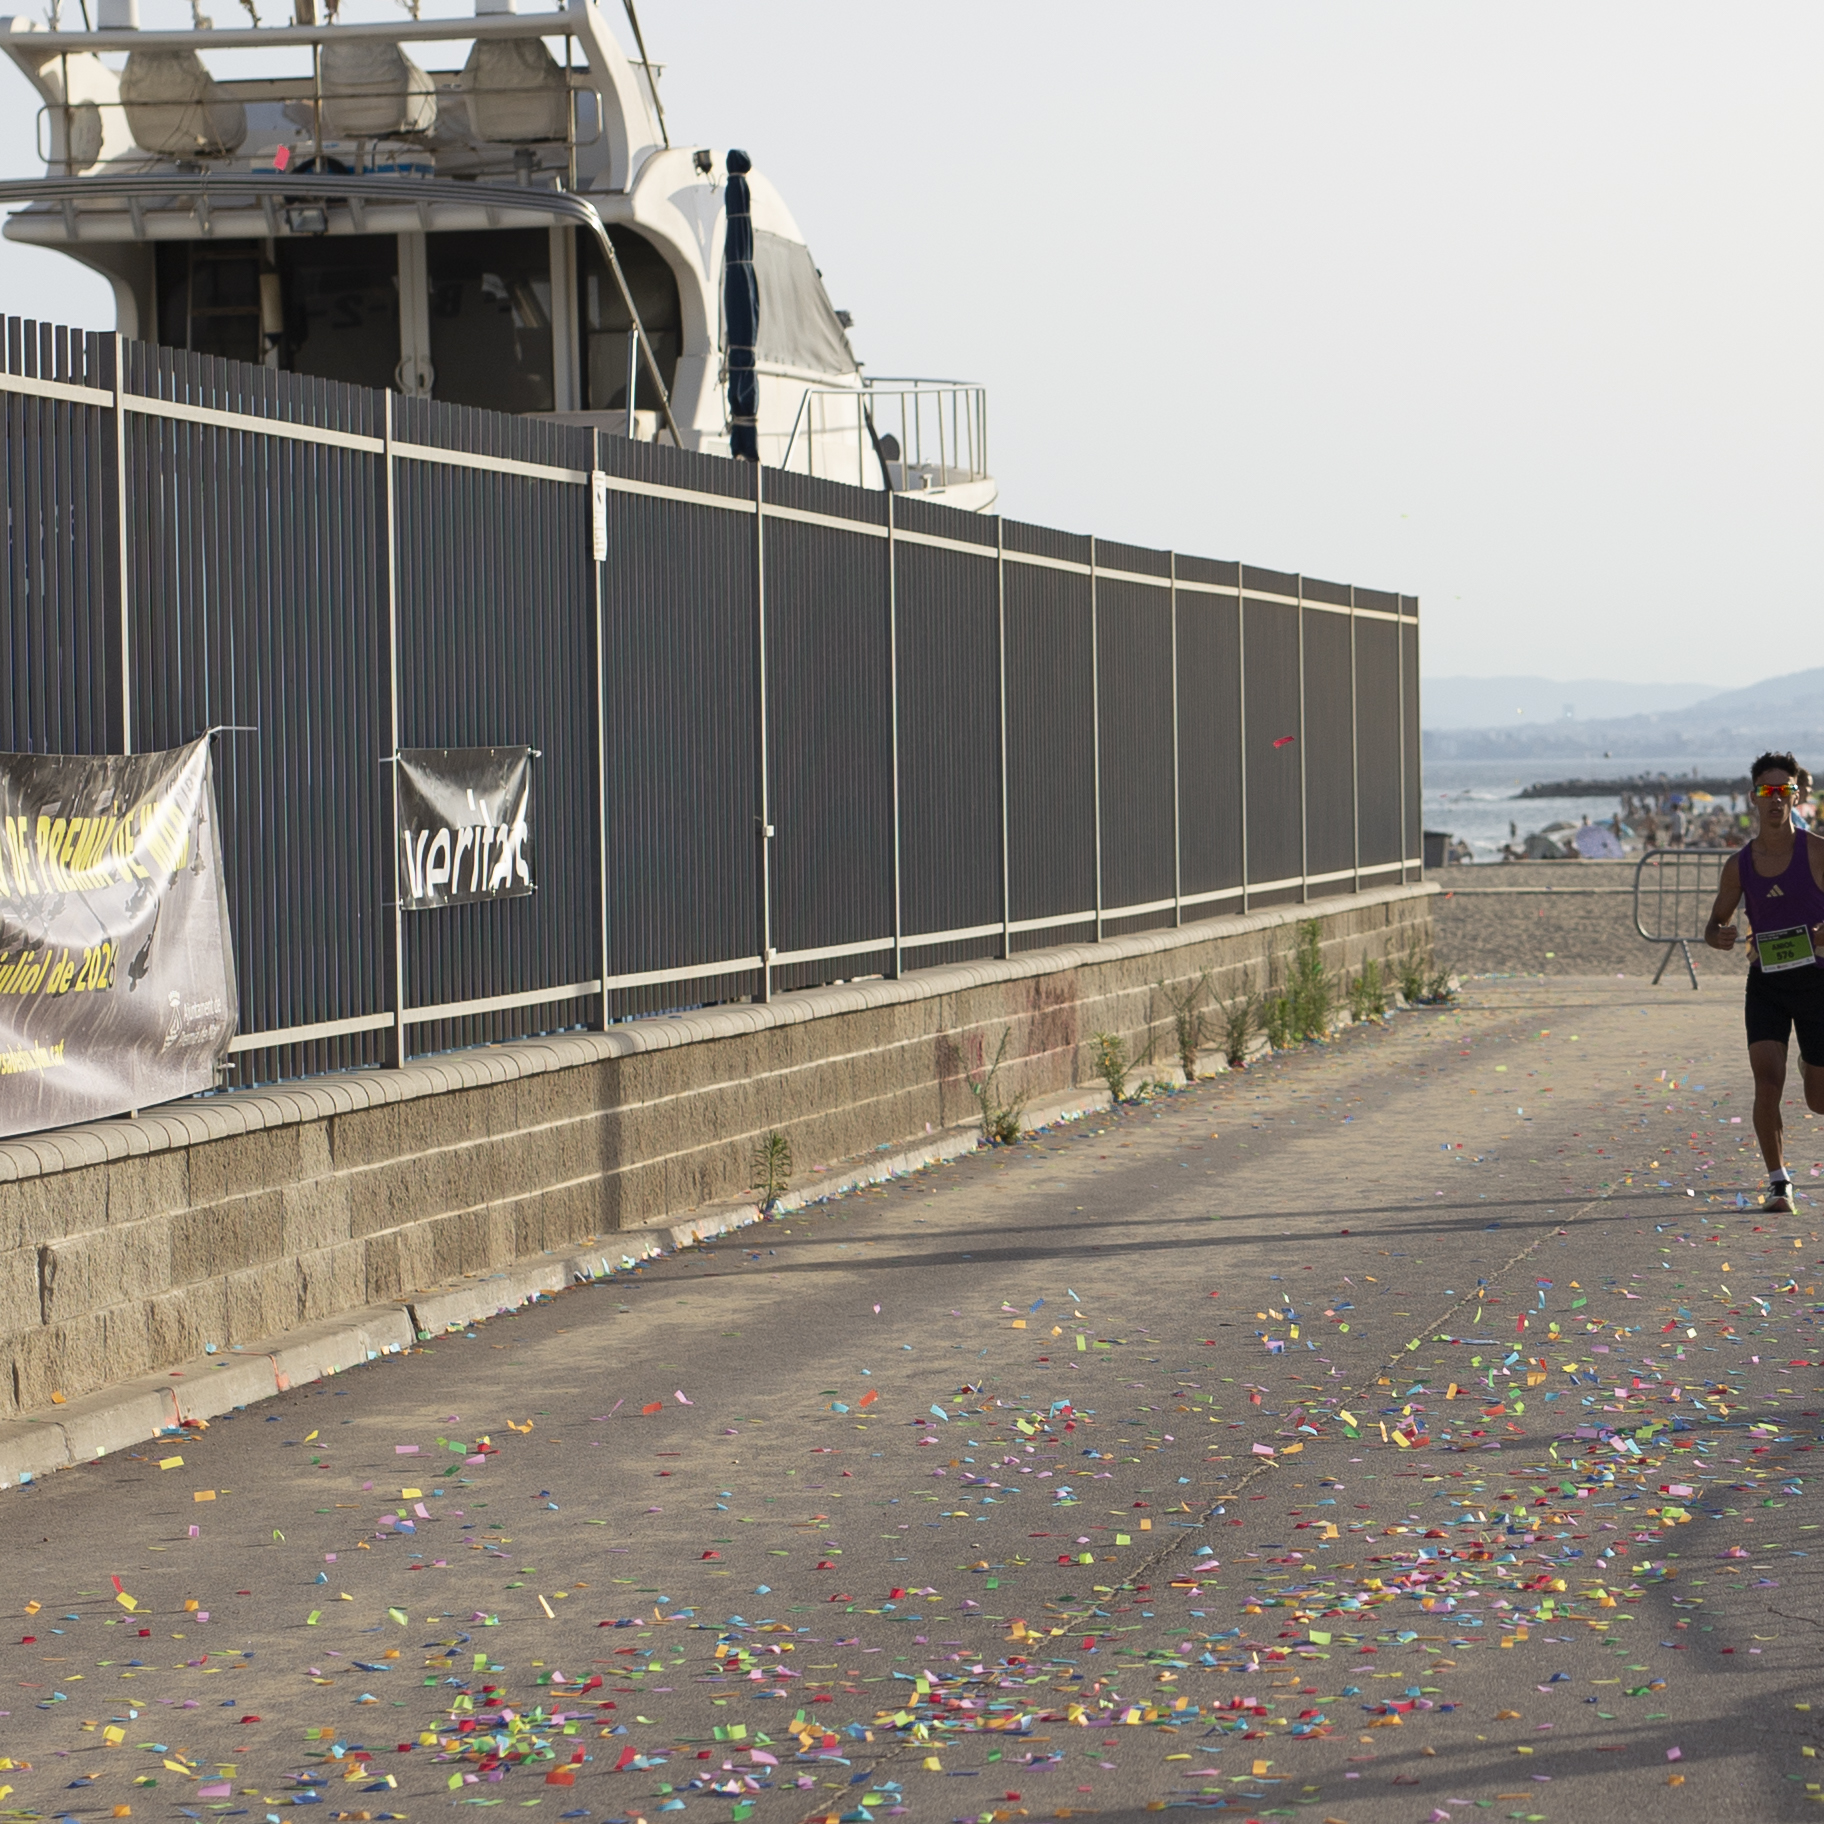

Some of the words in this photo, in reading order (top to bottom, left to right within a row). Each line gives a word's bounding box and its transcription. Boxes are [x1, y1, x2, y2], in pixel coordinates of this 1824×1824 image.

[404, 789, 530, 898] veritas
[46, 947, 75, 994] de
[1776, 950, 1794, 960] 576
